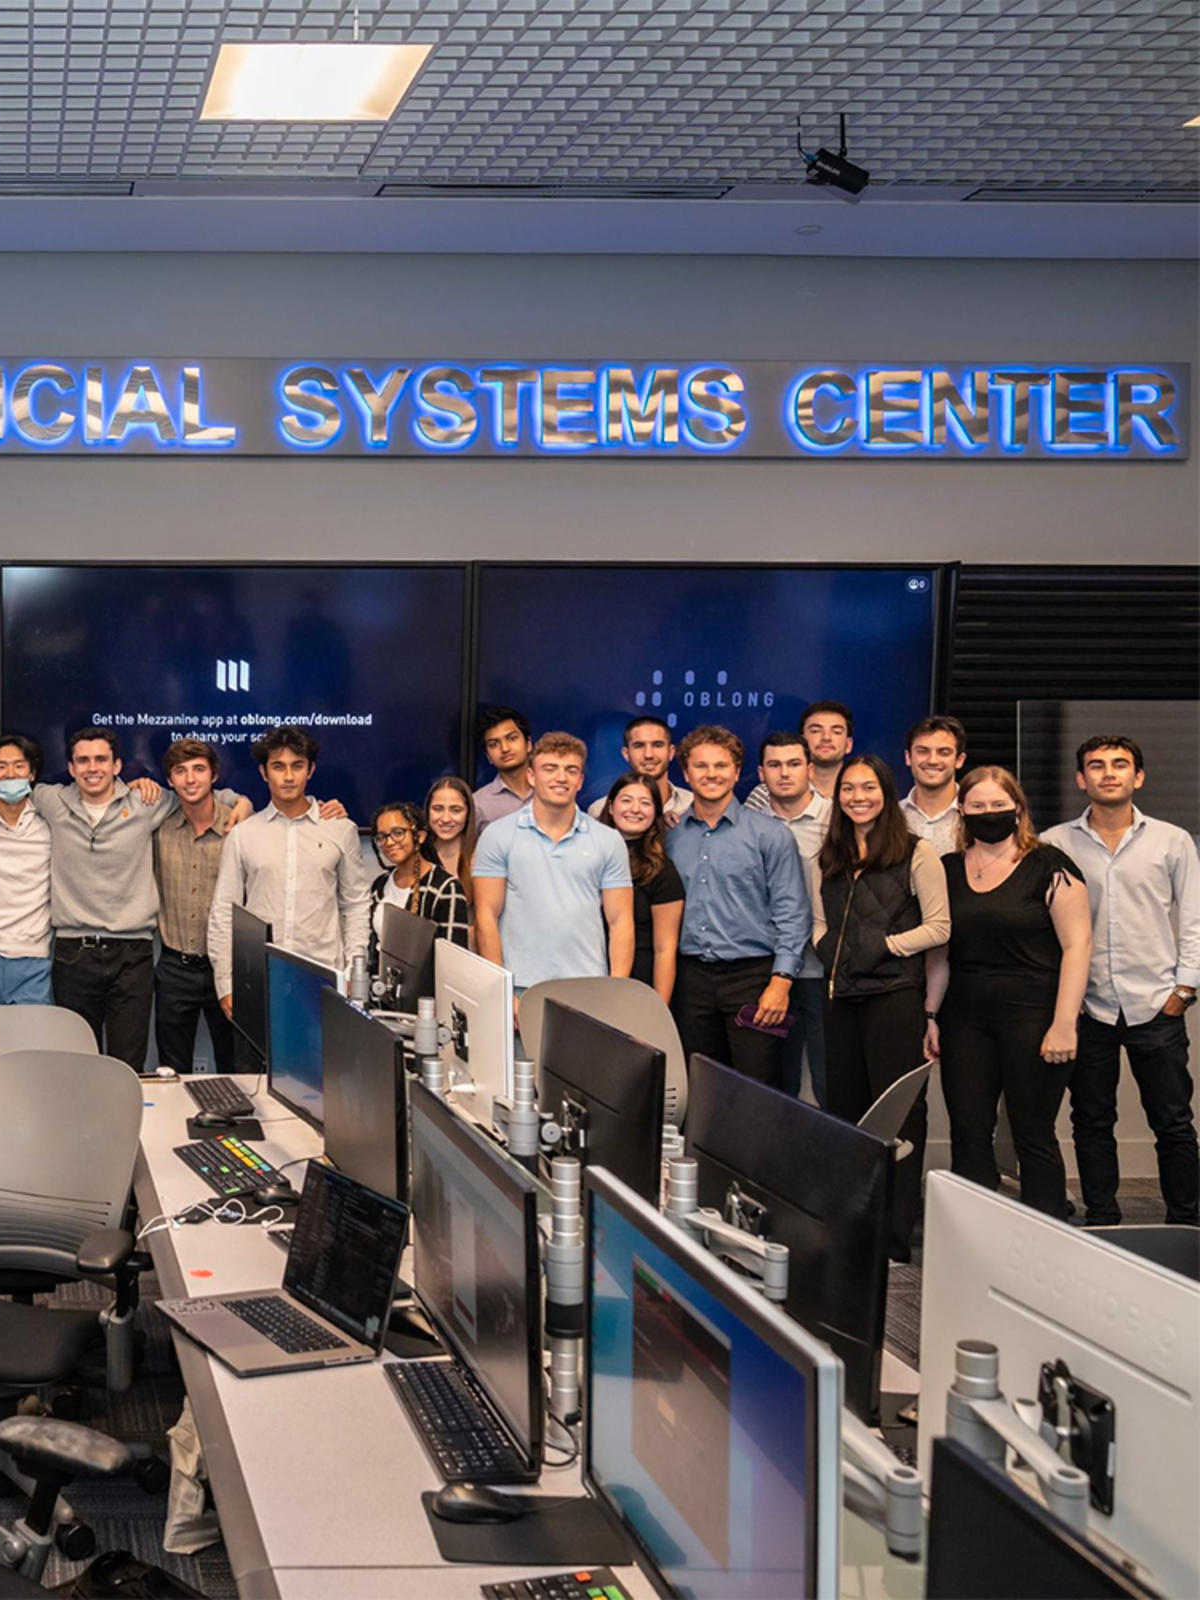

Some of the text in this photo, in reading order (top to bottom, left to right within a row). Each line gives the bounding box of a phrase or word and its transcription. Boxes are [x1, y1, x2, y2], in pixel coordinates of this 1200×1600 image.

[279, 365, 748, 445] SYSTEMS
[792, 369, 1181, 448] CENTER
[683, 691, 775, 708] OBLONG
[92, 712, 373, 729] Get the Mezzanine app at oblong.com/download
[171, 731, 183, 742] to
[185, 731, 219, 742] share
[221, 732, 248, 745] your
